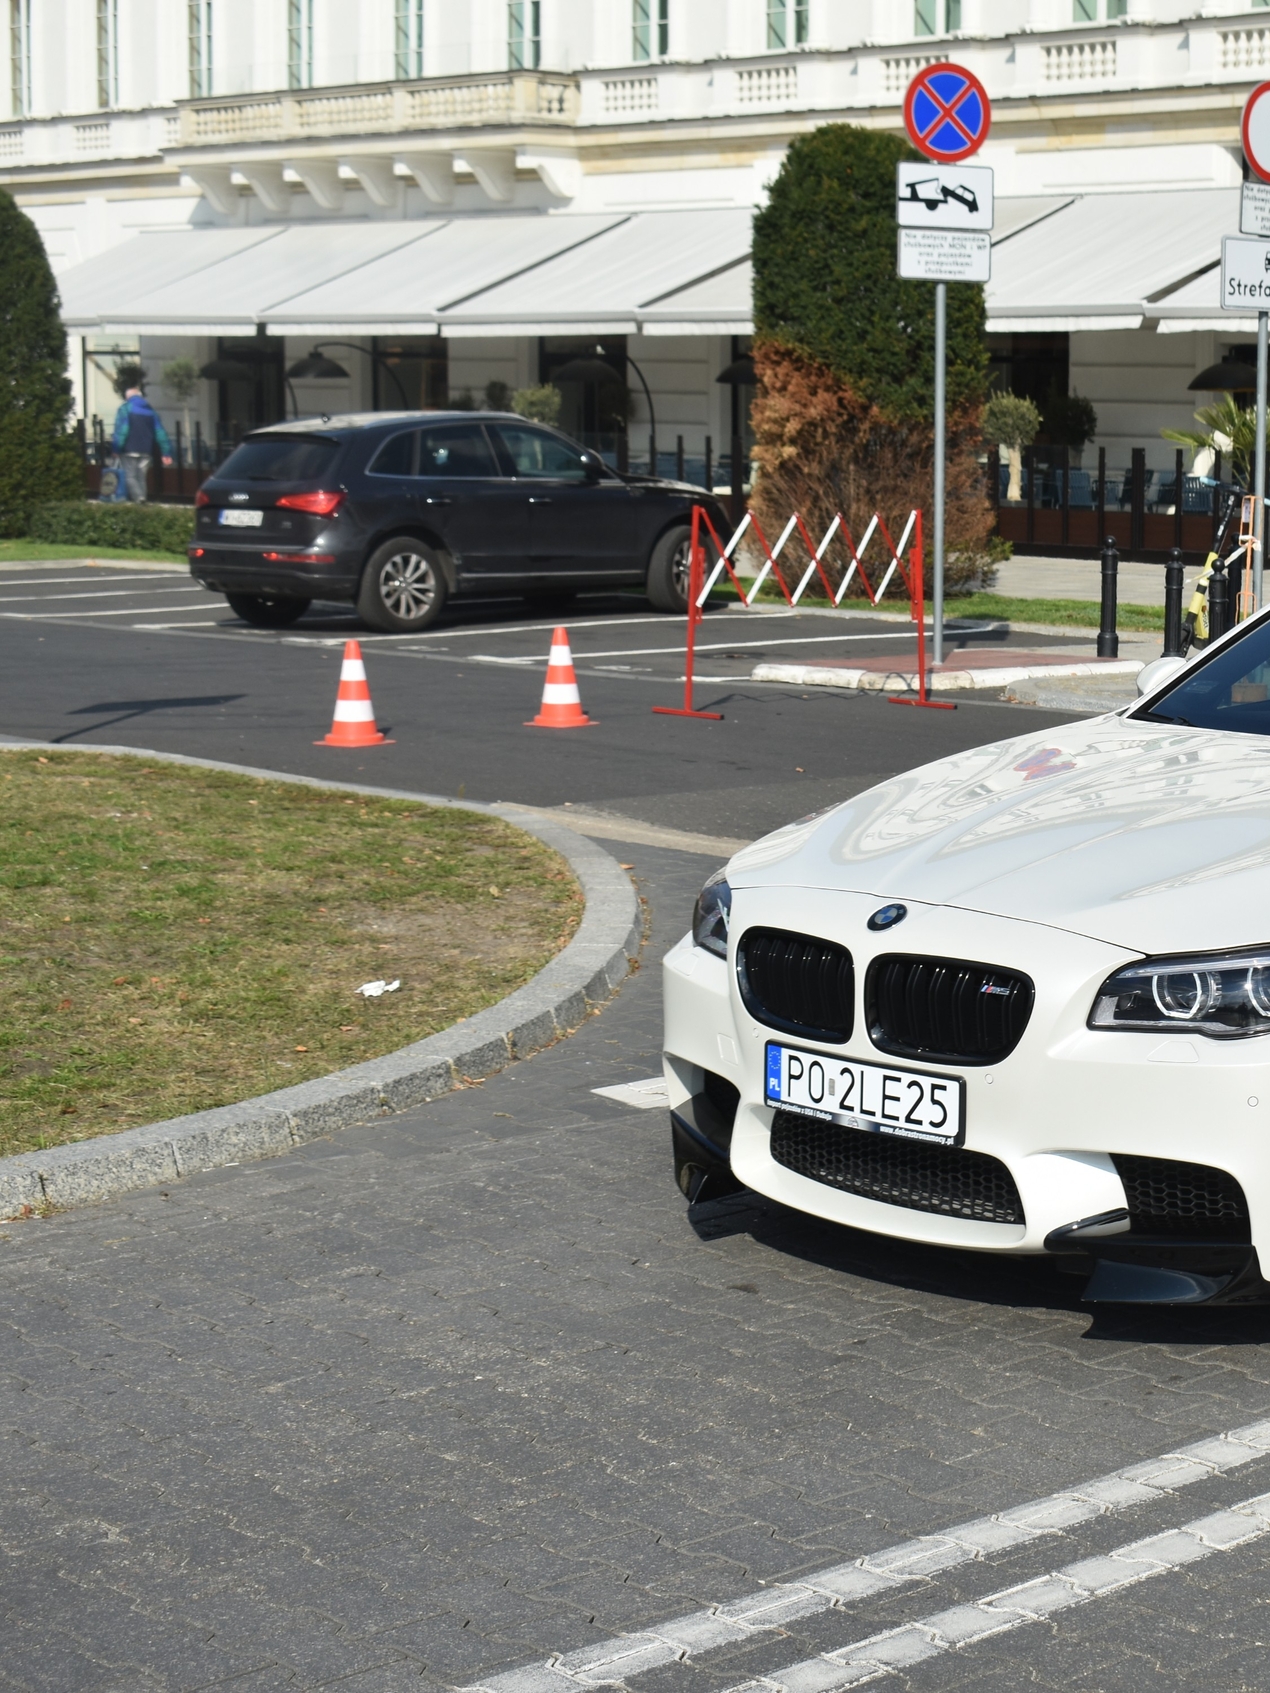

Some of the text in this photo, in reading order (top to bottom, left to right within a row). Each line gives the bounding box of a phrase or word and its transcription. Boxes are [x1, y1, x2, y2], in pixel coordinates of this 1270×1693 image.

[769, 1077, 780, 1091] PL
[788, 1054, 948, 1128] PO 2LE25
